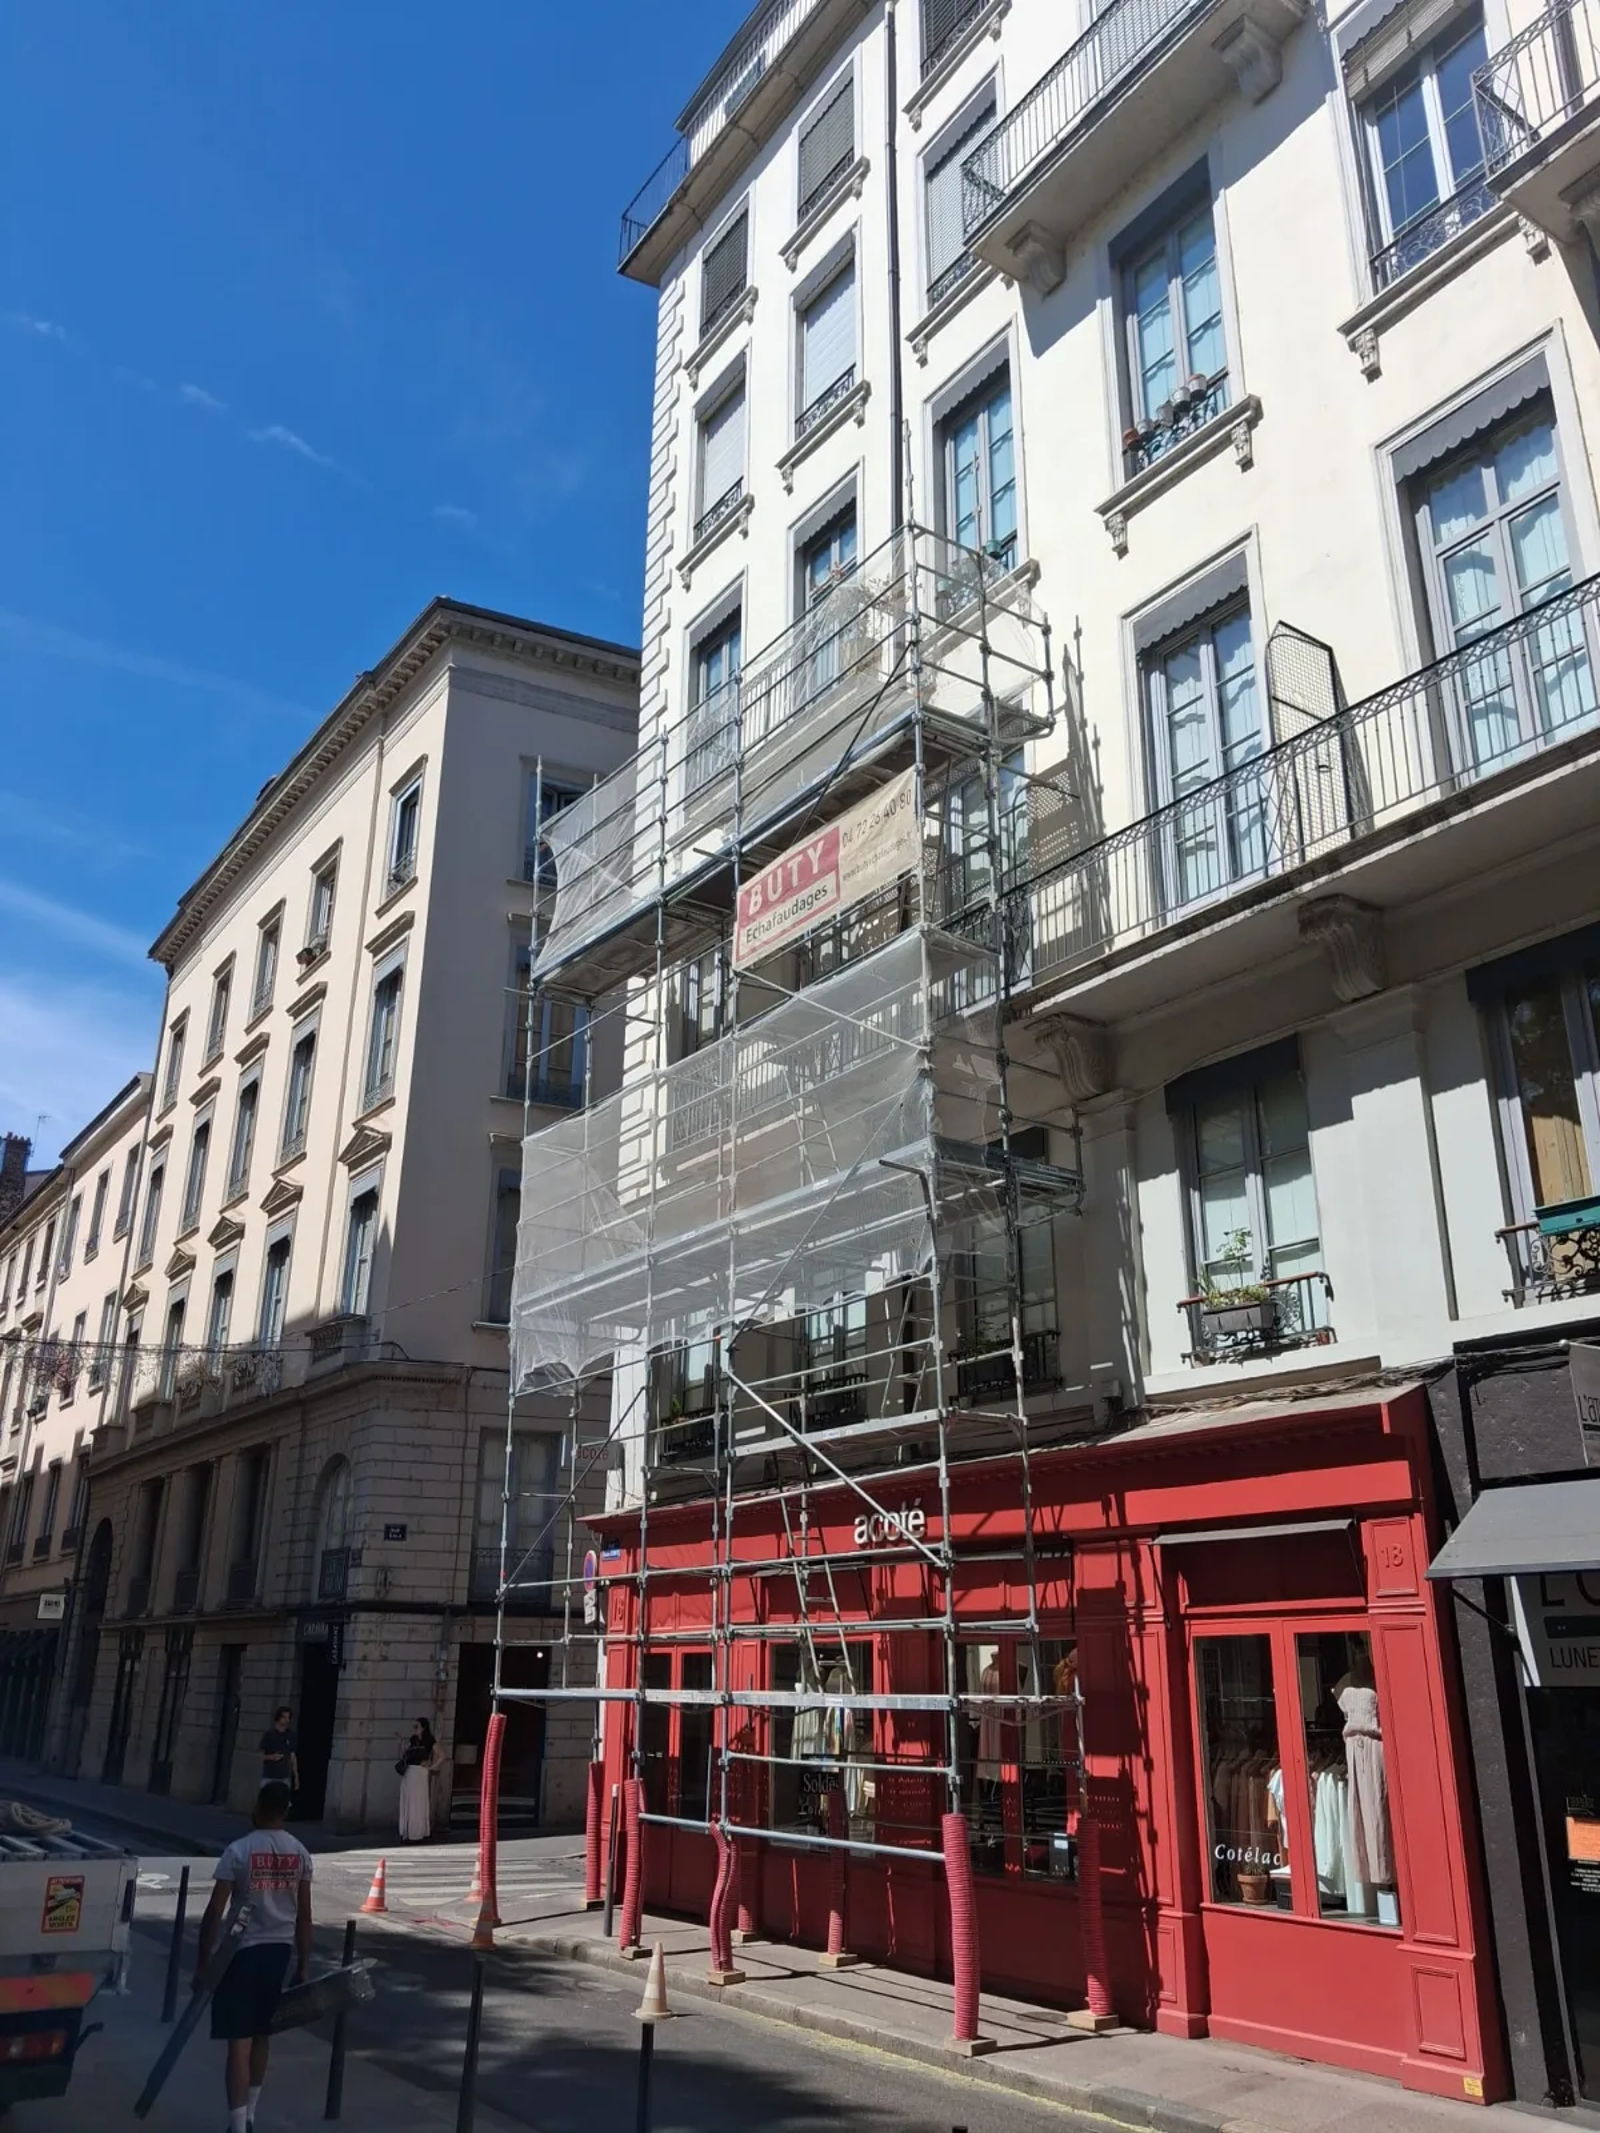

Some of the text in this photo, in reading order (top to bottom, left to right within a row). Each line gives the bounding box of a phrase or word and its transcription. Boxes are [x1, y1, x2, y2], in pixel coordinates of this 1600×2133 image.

[748, 840, 824, 916] BUTY
[746, 884, 828, 943] Echafaudages
[854, 1497, 925, 1545] acoté
[1380, 1544, 1404, 1568] 18
[1549, 1646, 1600, 1669] LUNE
[256, 1855, 295, 1868] BUTY
[1214, 1843, 1282, 1866] Cotélac
